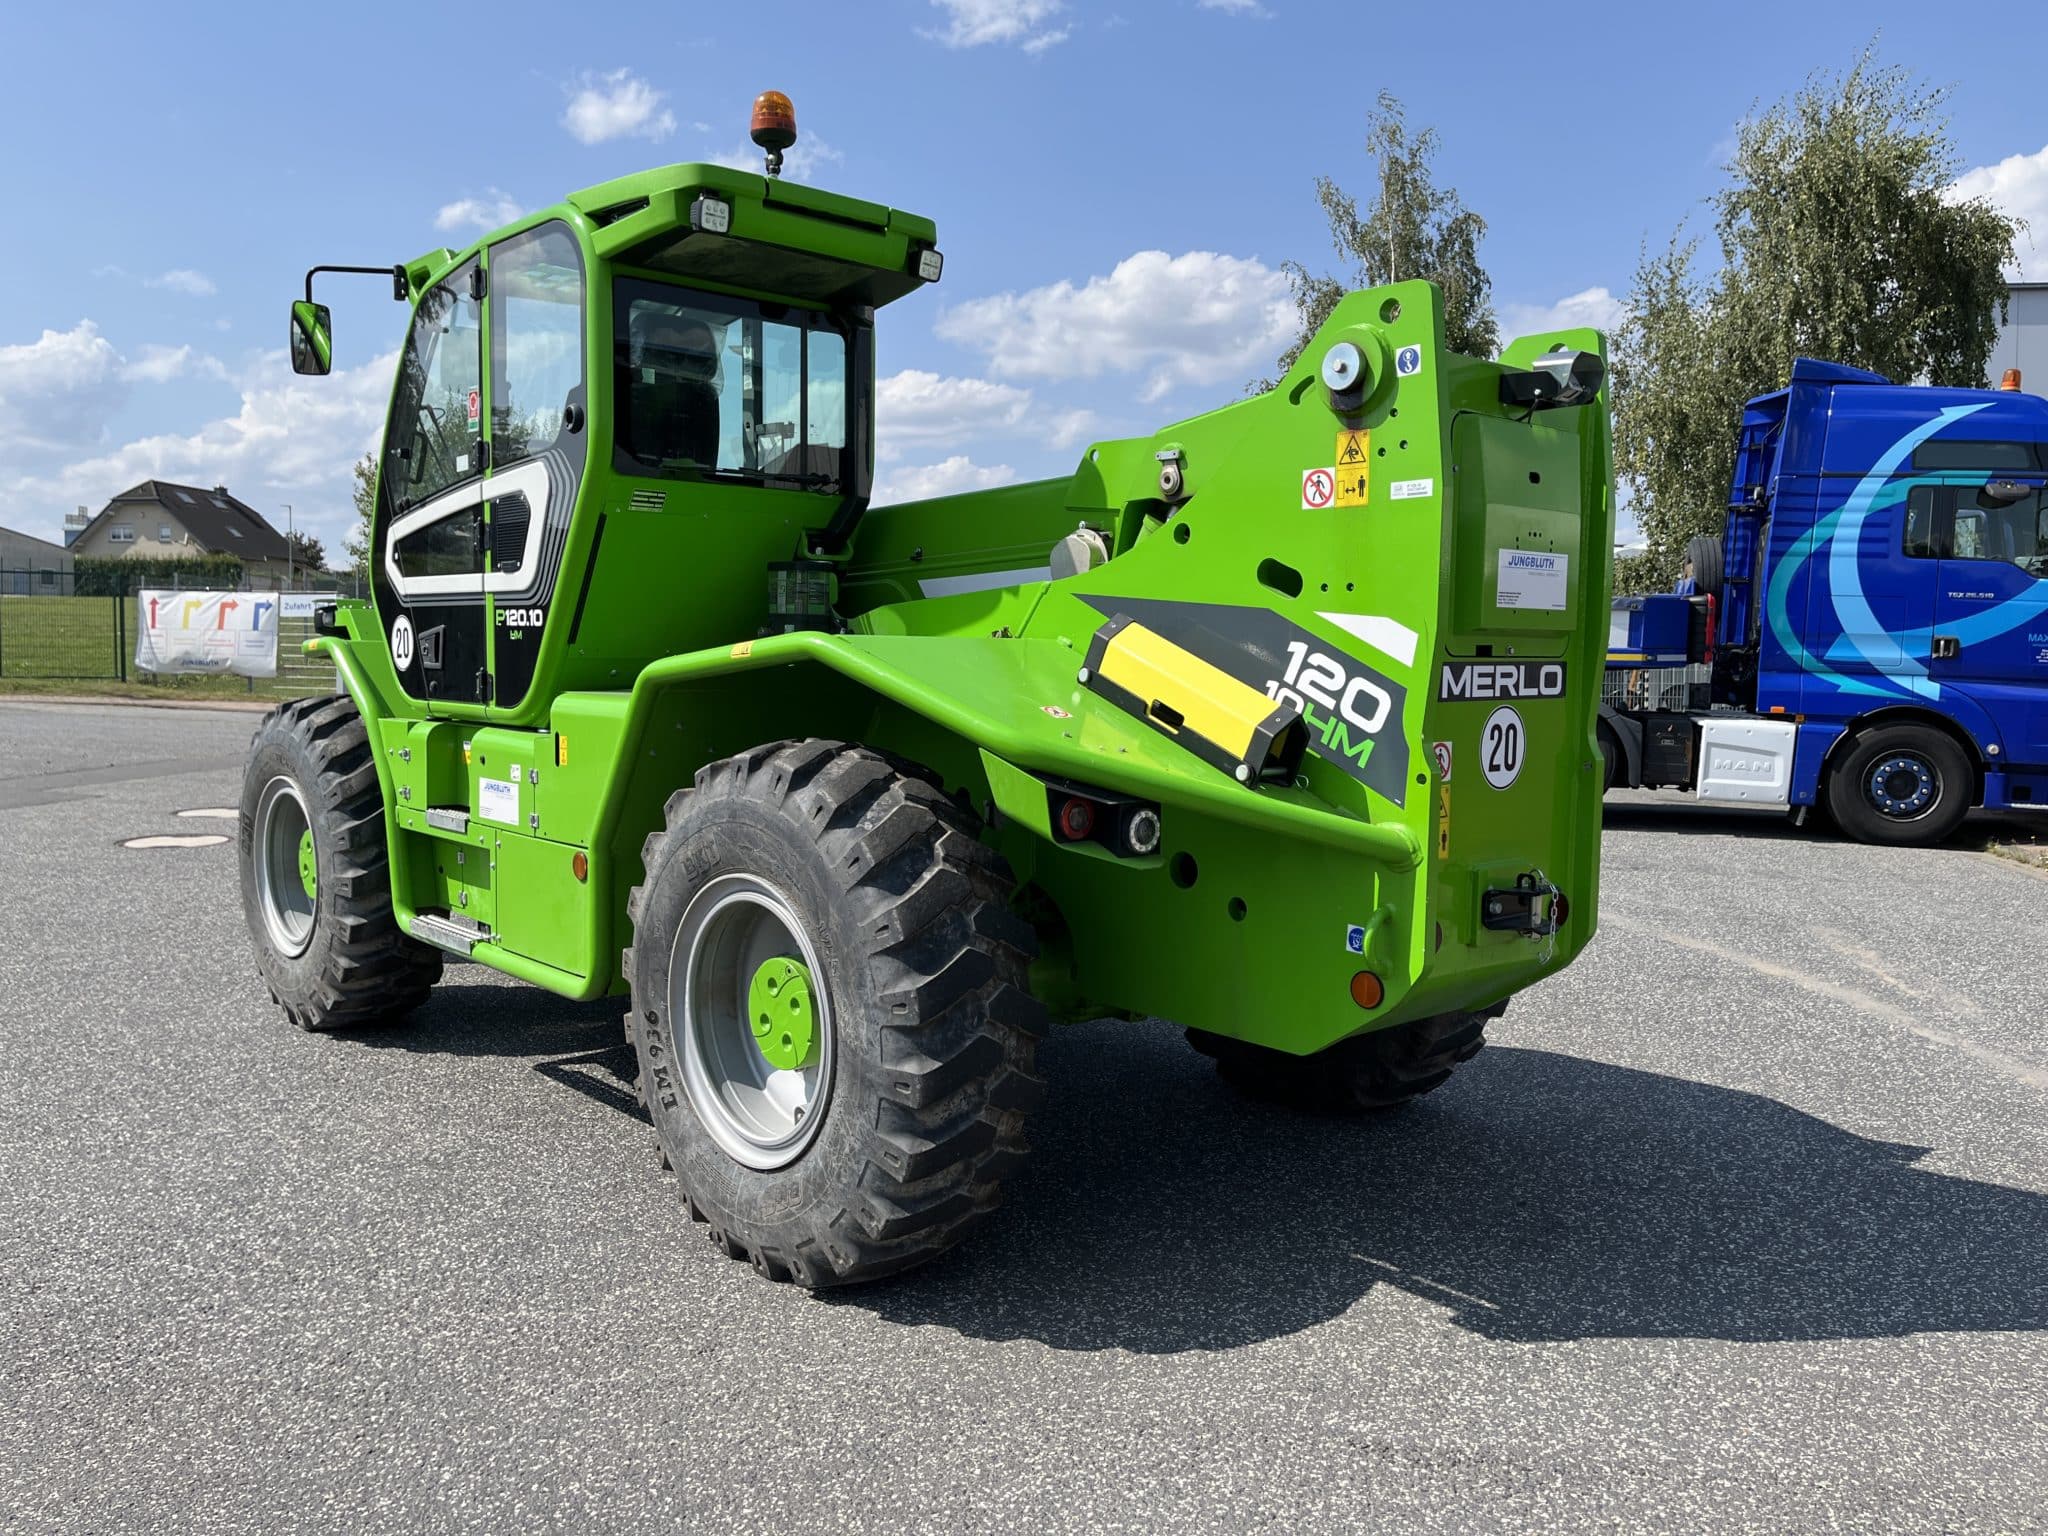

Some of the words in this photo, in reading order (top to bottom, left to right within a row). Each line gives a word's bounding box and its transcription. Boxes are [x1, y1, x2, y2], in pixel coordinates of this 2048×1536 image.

[1508, 555, 1555, 569] JUNGBLUTH
[284, 602, 312, 610] Zufahrt
[495, 608, 543, 627] P120.10
[396, 627, 410, 659] 20
[1282, 640, 1392, 734] 120
[1441, 664, 1563, 699] MERLO
[1488, 722, 1518, 772] 20
[1714, 758, 1772, 773] MAN
[643, 1010, 664, 1058] 936
